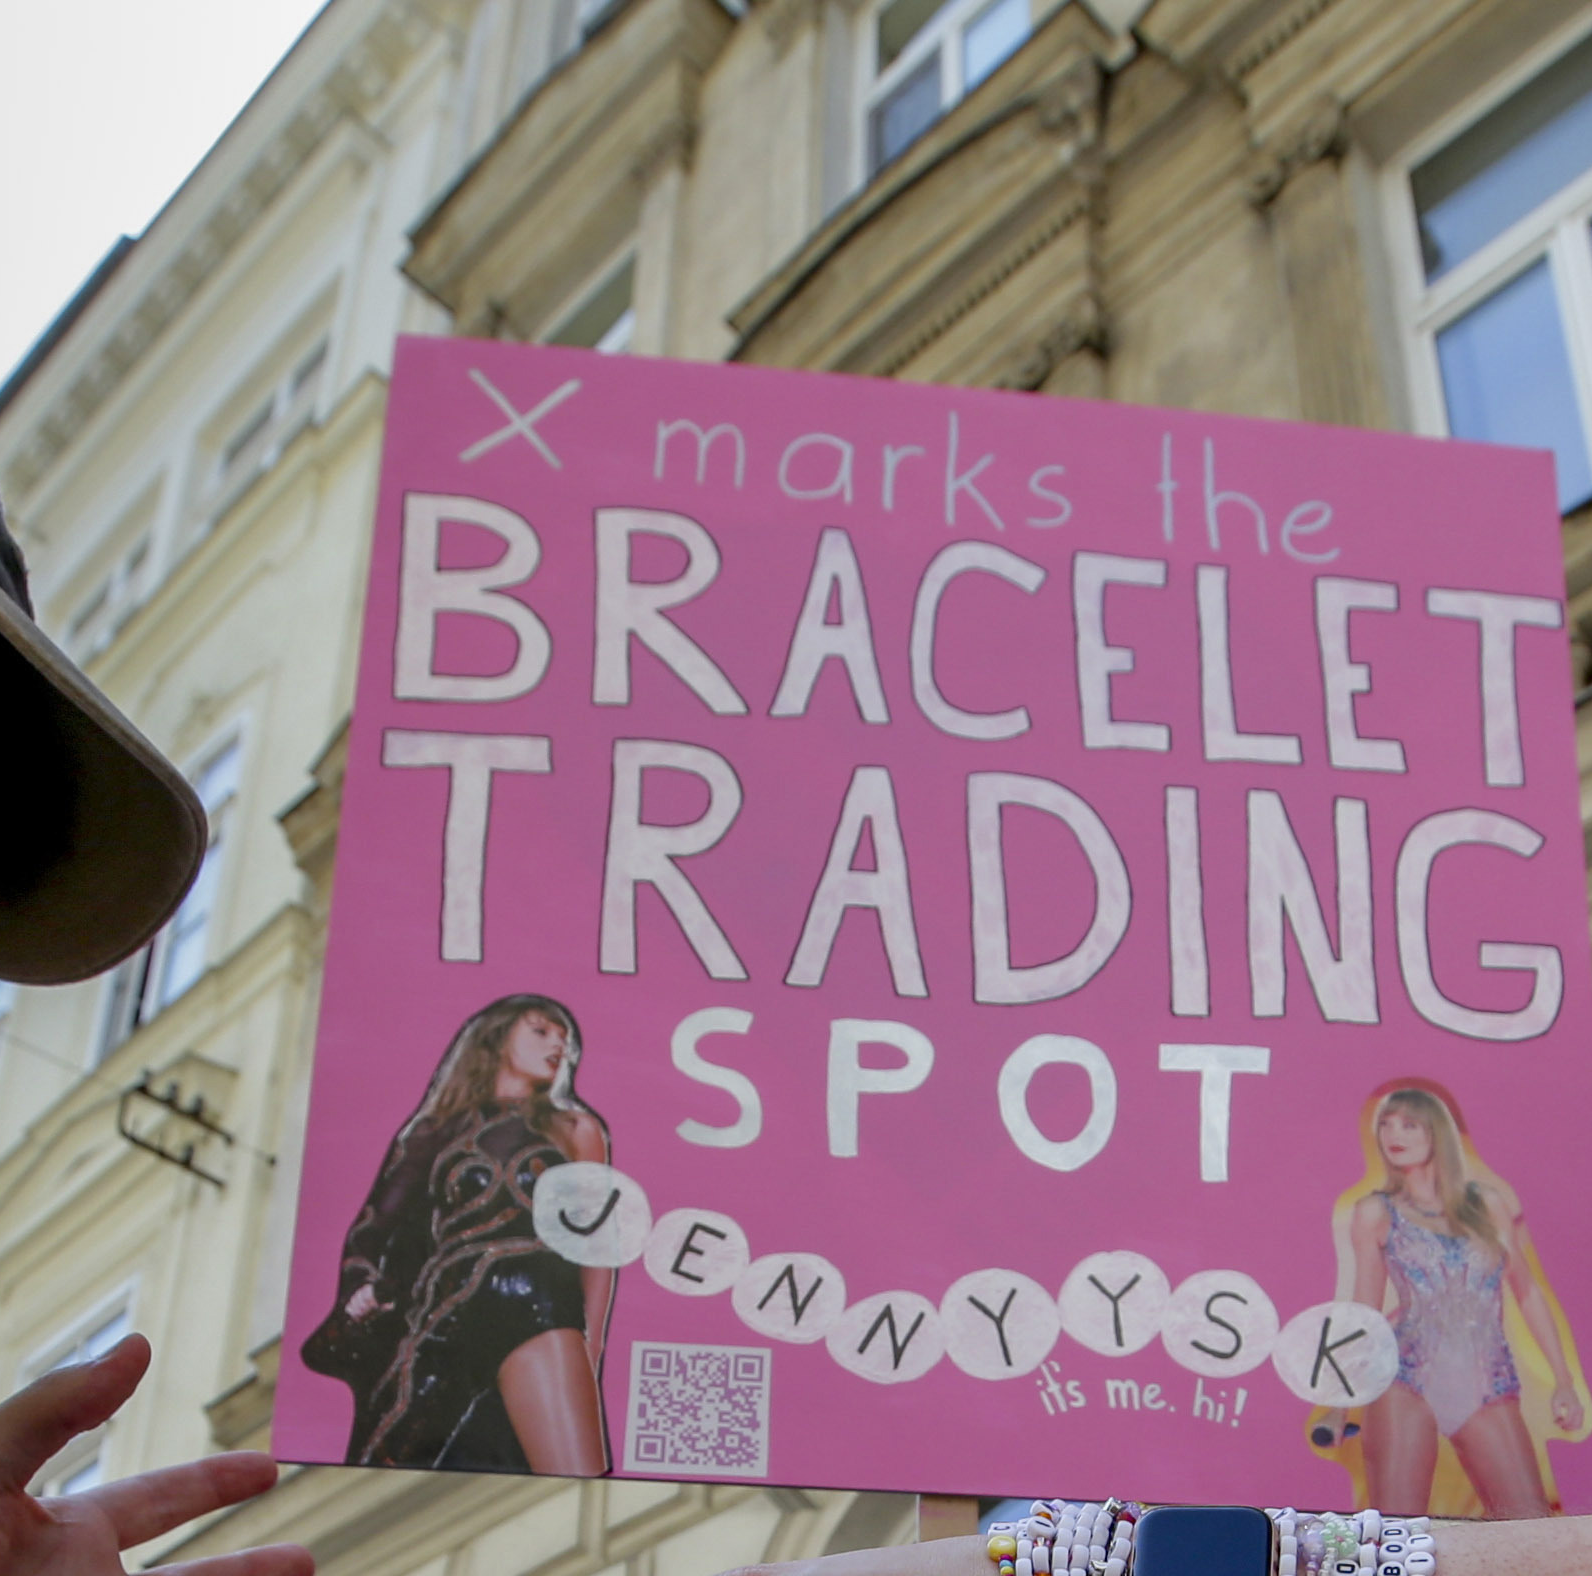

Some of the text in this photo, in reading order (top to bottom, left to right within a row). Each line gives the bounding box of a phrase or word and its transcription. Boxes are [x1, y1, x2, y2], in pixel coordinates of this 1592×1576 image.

[459, 368, 1342, 564] X marks the
[393, 491, 1564, 789] BRACELET
[383, 730, 1565, 1042] TRADING
[669, 1005, 1273, 1185] SPOT
[551, 1180, 1375, 1402] JENNYYSK
[1192, 1377, 1249, 1429] hi!
